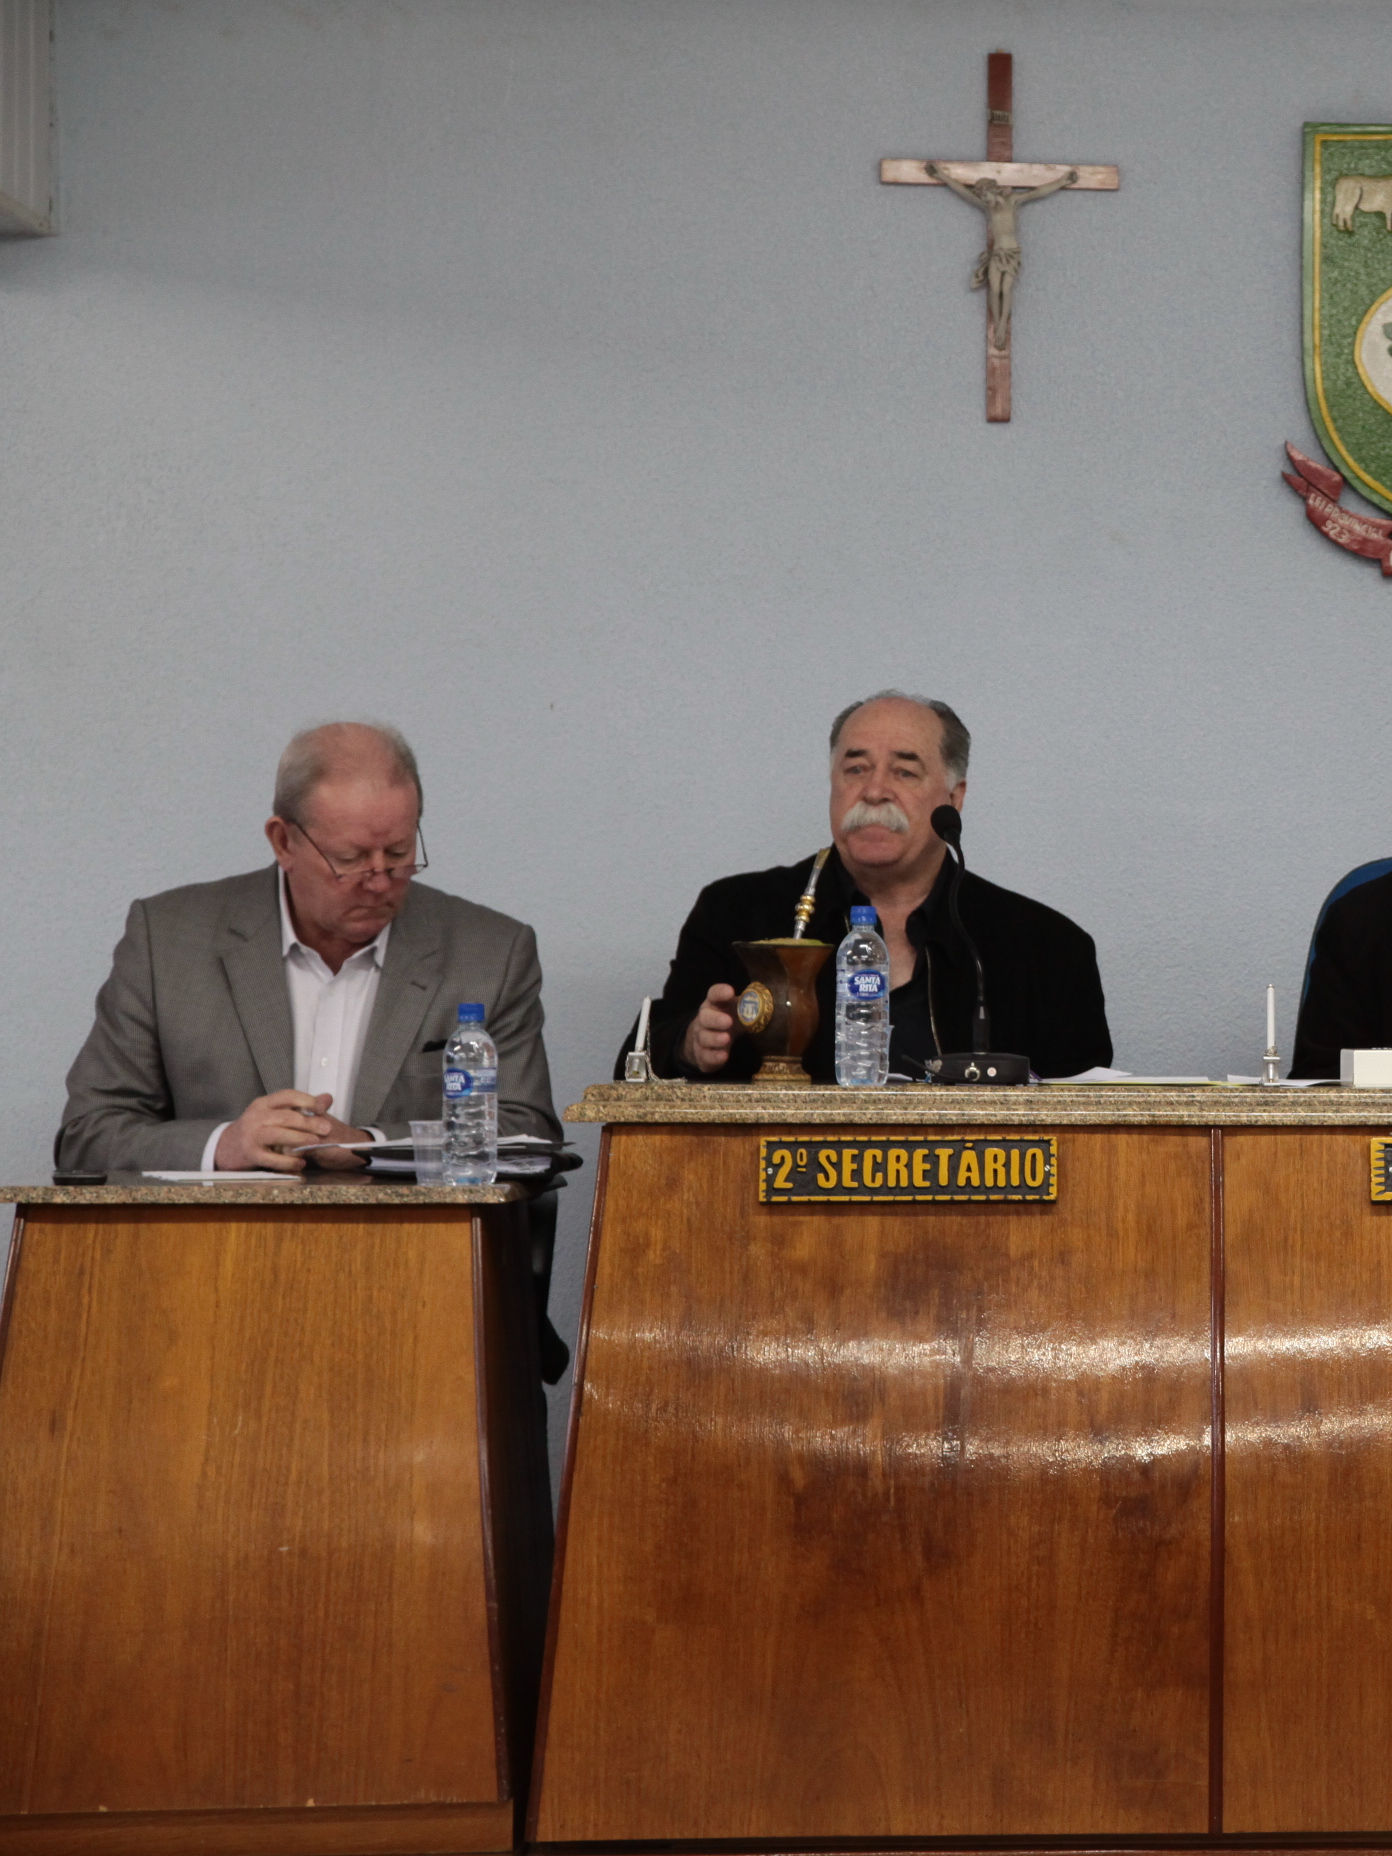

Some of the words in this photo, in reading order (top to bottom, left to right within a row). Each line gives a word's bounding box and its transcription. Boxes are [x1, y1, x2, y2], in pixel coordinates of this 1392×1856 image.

[854, 976, 881, 986] SANTA
[859, 984, 878, 993] RITA
[771, 1148, 808, 1190] 2º
[816, 1142, 1046, 1189] SECRETÁRIO
